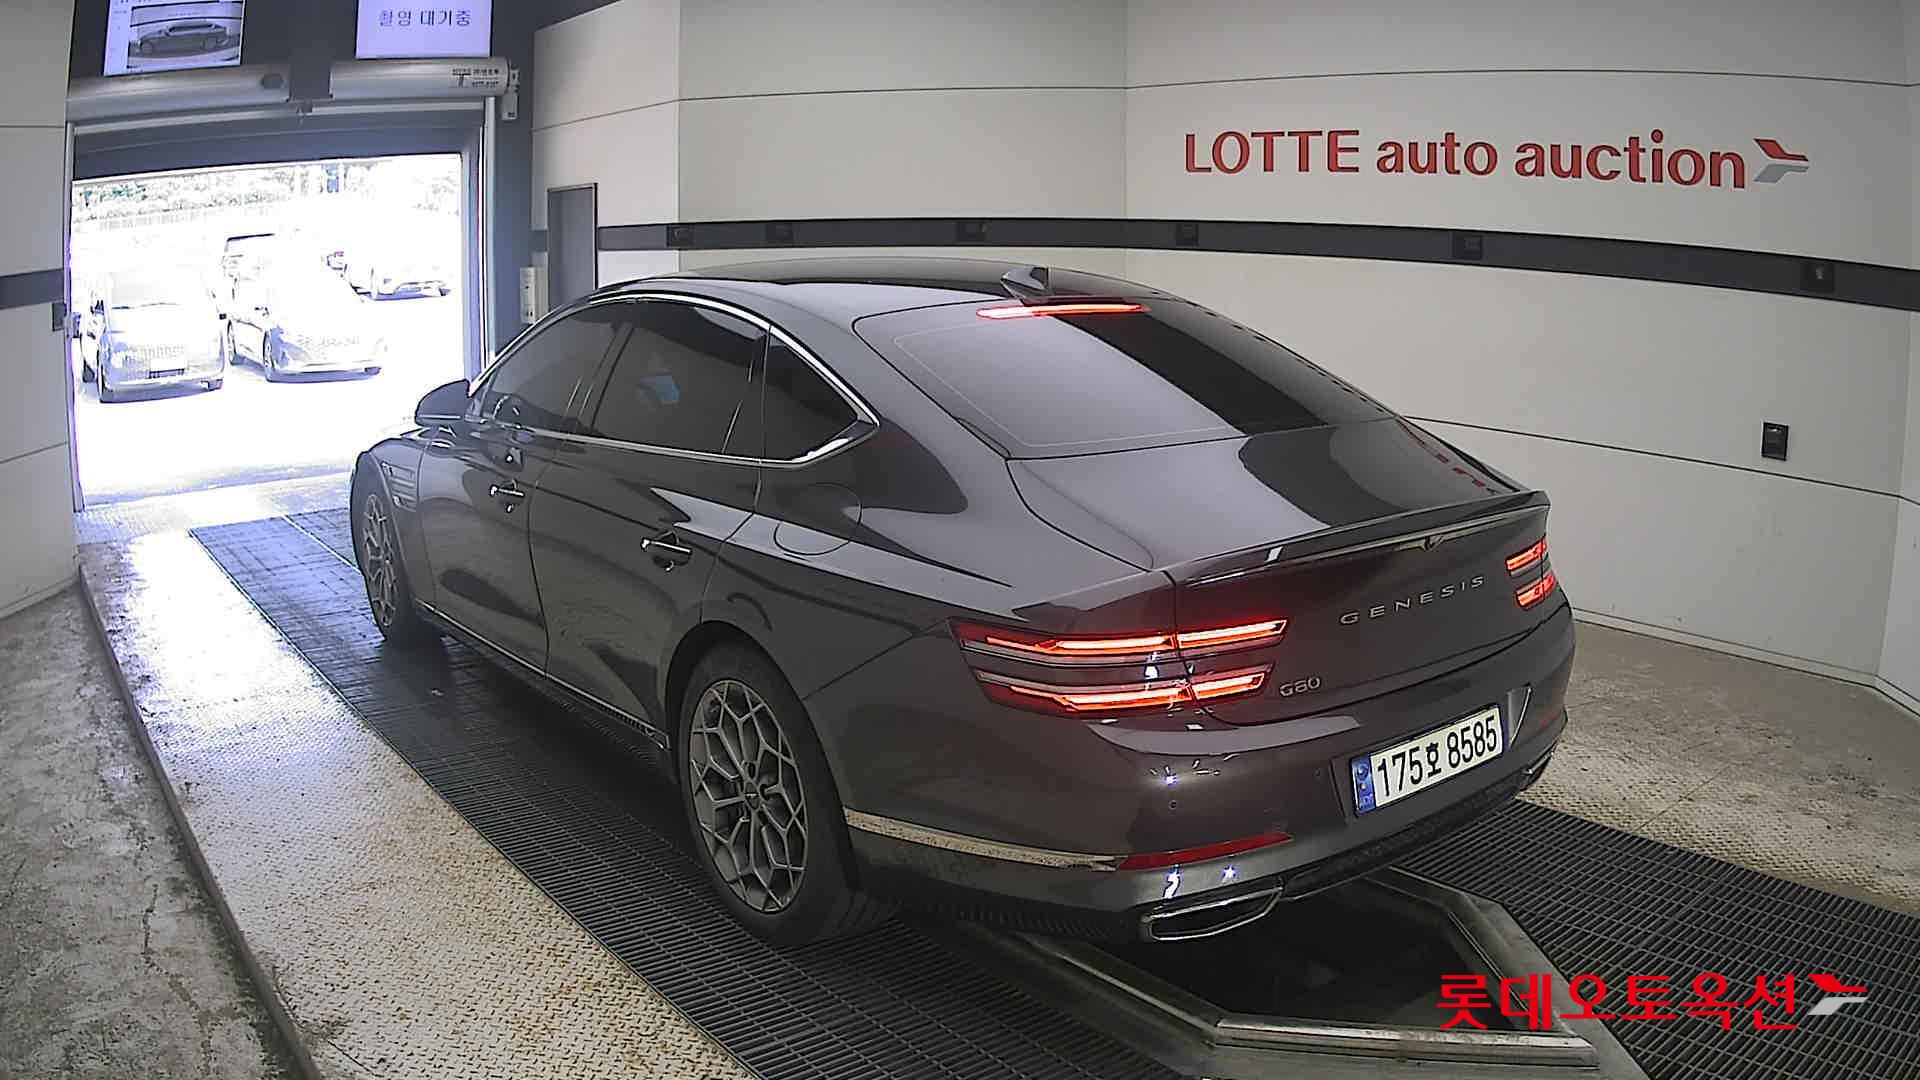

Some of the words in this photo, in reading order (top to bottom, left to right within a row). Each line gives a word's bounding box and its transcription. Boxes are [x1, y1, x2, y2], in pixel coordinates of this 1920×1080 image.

[420, 9, 472, 27] 대기중
[1185, 130, 1359, 174] LOTTE
[1376, 133, 1499, 177] auto
[1513, 129, 1746, 189] auction
[1339, 575, 1485, 625] GENESIS
[1279, 676, 1322, 698] G80
[1446, 715, 1497, 769] 8585
